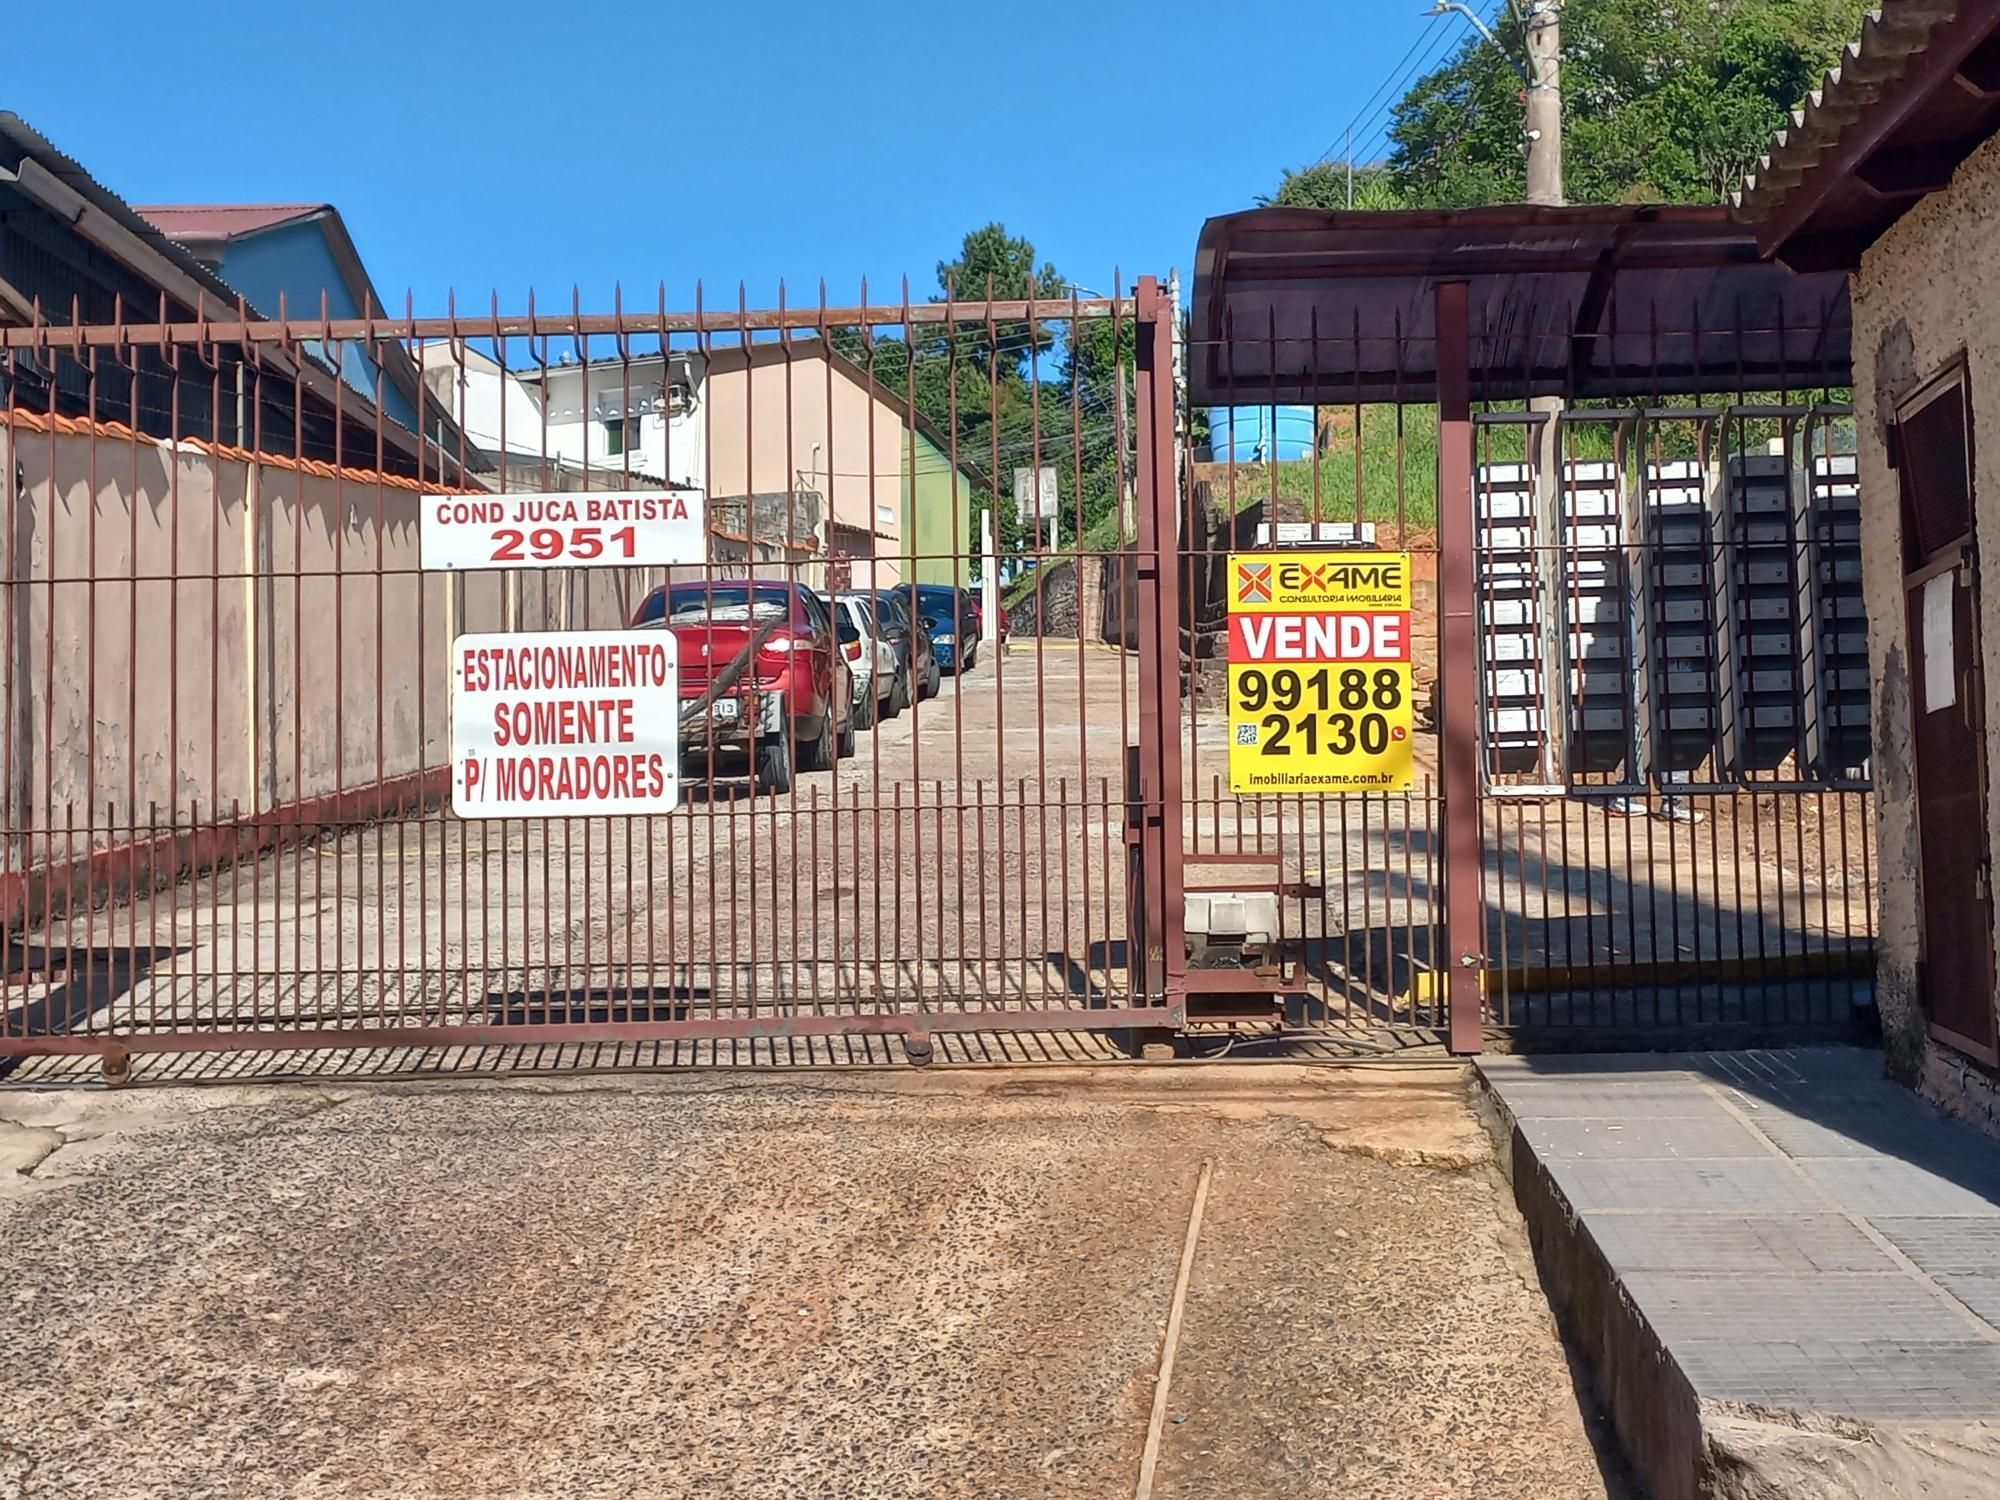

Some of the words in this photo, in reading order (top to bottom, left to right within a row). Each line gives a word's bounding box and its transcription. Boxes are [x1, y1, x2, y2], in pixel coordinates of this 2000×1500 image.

[436, 503, 504, 524] COND
[512, 500, 578, 523] JUCA
[587, 498, 689, 521] BATISTA
[490, 526, 635, 561] 2951
[1279, 563, 1401, 592] EXAME
[1279, 595, 1344, 603] CONSULTORIA
[1239, 615, 1401, 659] VENDE
[463, 644, 666, 692] ESTACIONAMENTO
[1238, 668, 1401, 712] 99188
[494, 700, 634, 746] SOMENTE
[1261, 712, 1389, 756] 2130
[465, 756, 487, 802] P/
[496, 754, 664, 801] MORADORES
[1249, 772, 1394, 785] imobiliariaexame.com.br
